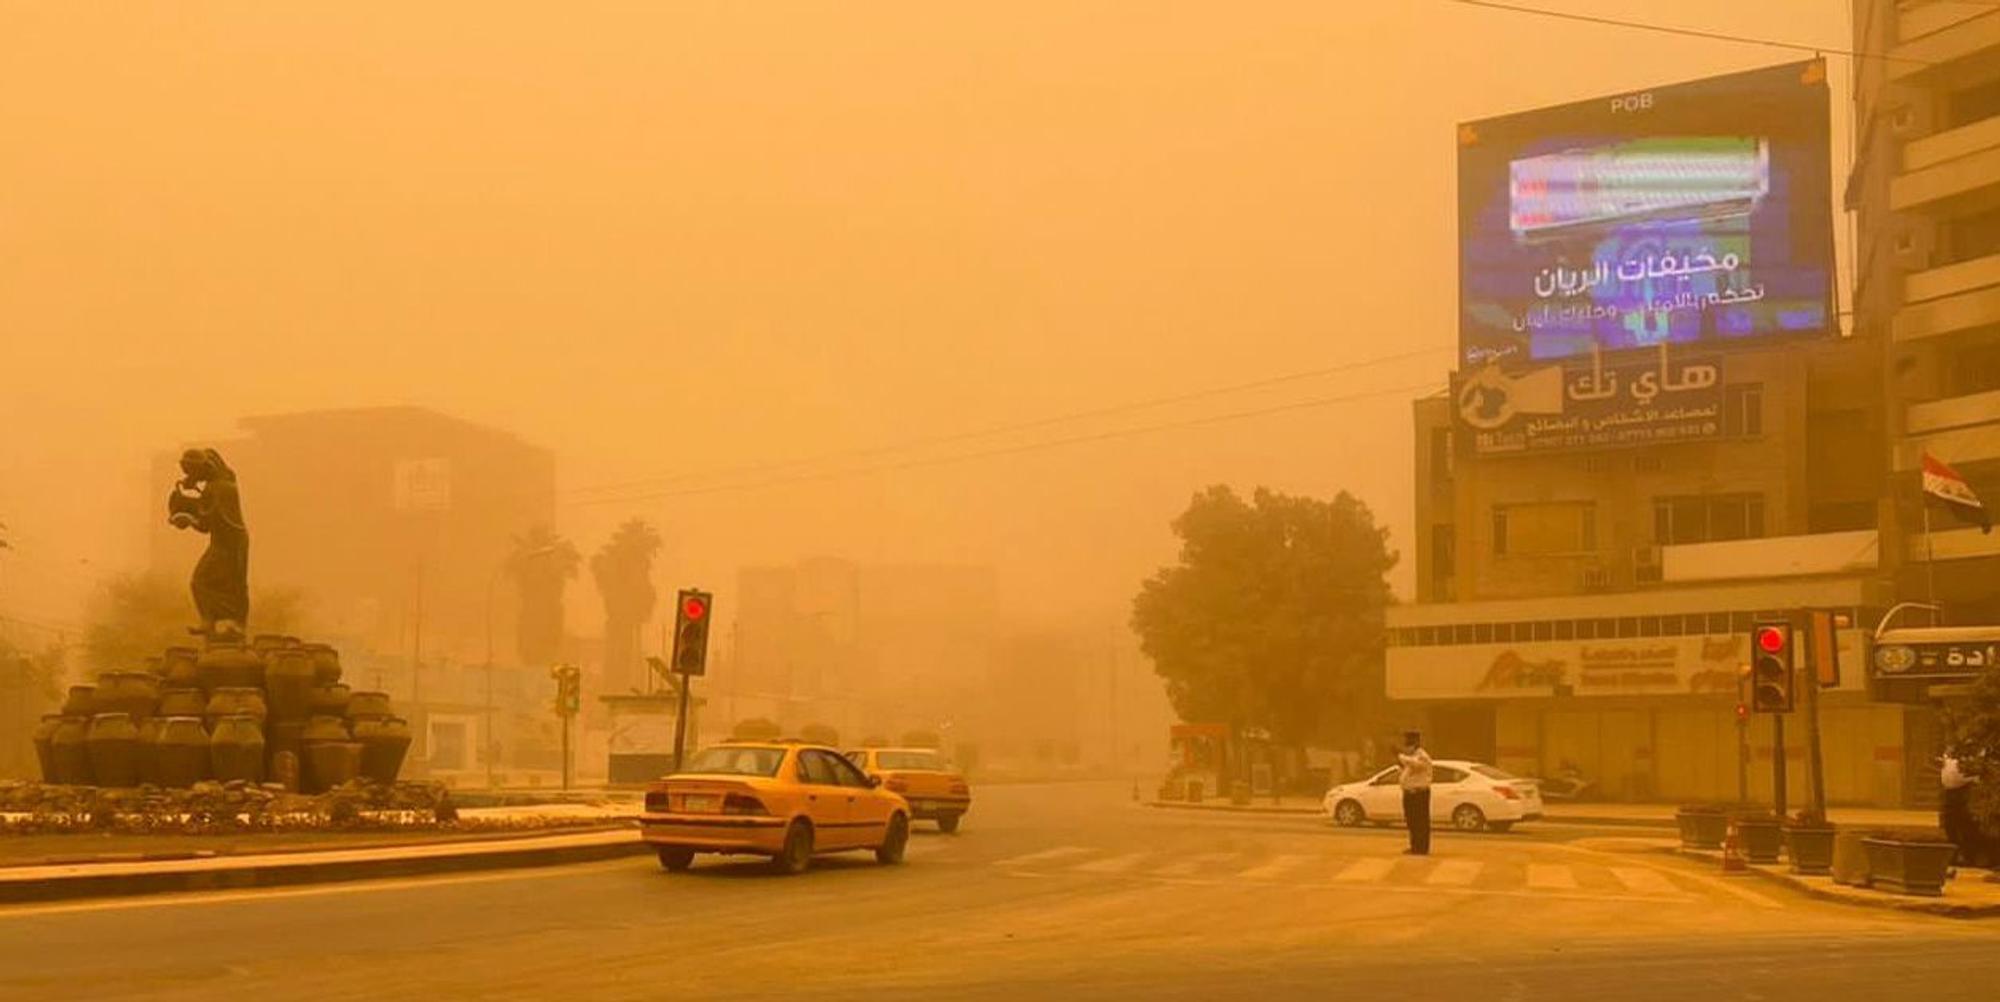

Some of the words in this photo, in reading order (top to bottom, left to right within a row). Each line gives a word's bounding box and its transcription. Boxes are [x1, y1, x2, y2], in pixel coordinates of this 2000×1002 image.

[1611, 93, 1653, 114] POB
[1534, 260, 1609, 298] الريان
[1568, 343, 1617, 400] تك
[1630, 343, 1716, 406] هاي
